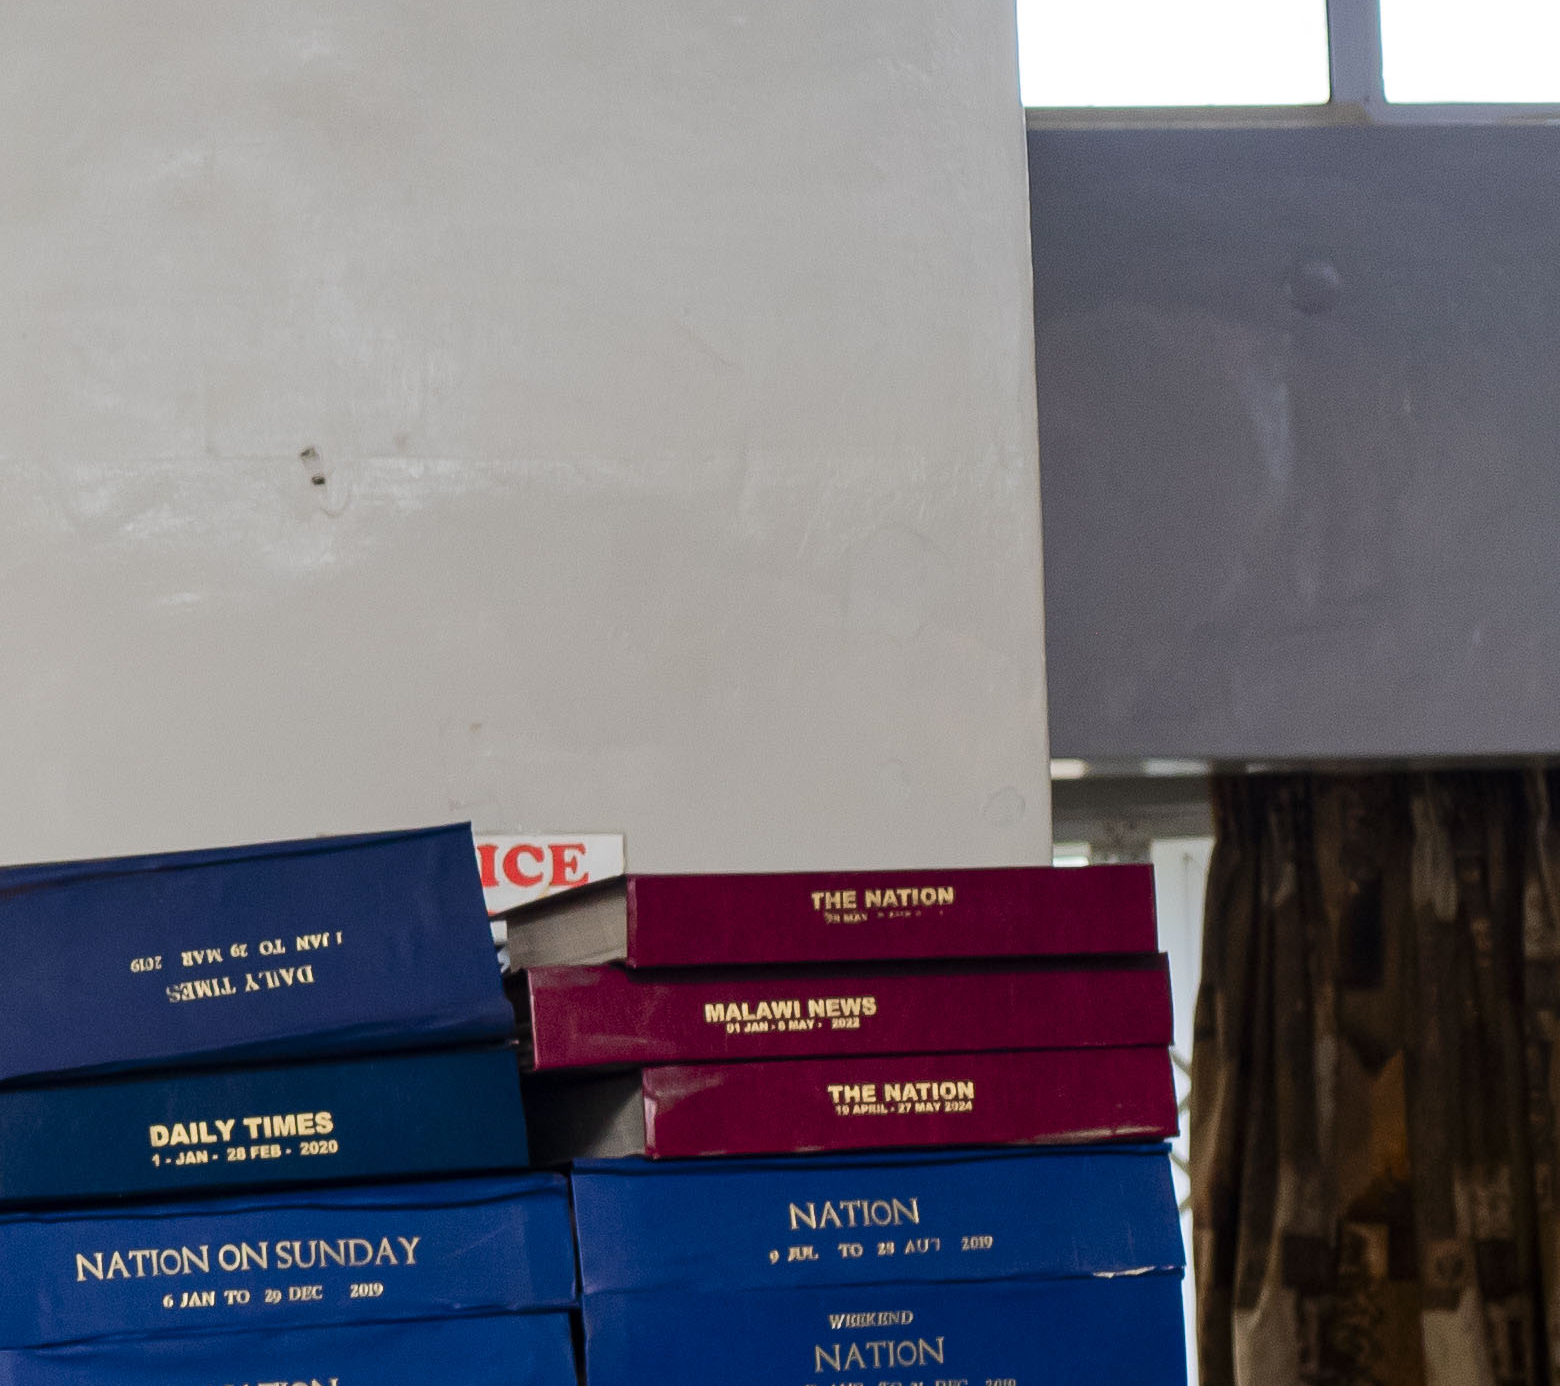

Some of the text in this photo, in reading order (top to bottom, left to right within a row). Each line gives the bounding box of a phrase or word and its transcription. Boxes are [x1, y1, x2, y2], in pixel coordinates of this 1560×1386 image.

[705, 997, 876, 1022] MALAWI NEWS
[828, 1082, 974, 1103] THE NATION
[790, 1198, 919, 1229] NATION
[76, 1237, 419, 1281] NATION ON SUNDAY
[163, 1295, 173, 1308] 6
[180, 1291, 215, 1307] JAN
[224, 1290, 250, 1304] TO
[289, 1285, 322, 1301] DEC
[351, 1283, 383, 1298] 2019
[829, 1311, 913, 1329] WEEKEND
[815, 1337, 944, 1372] NATION
